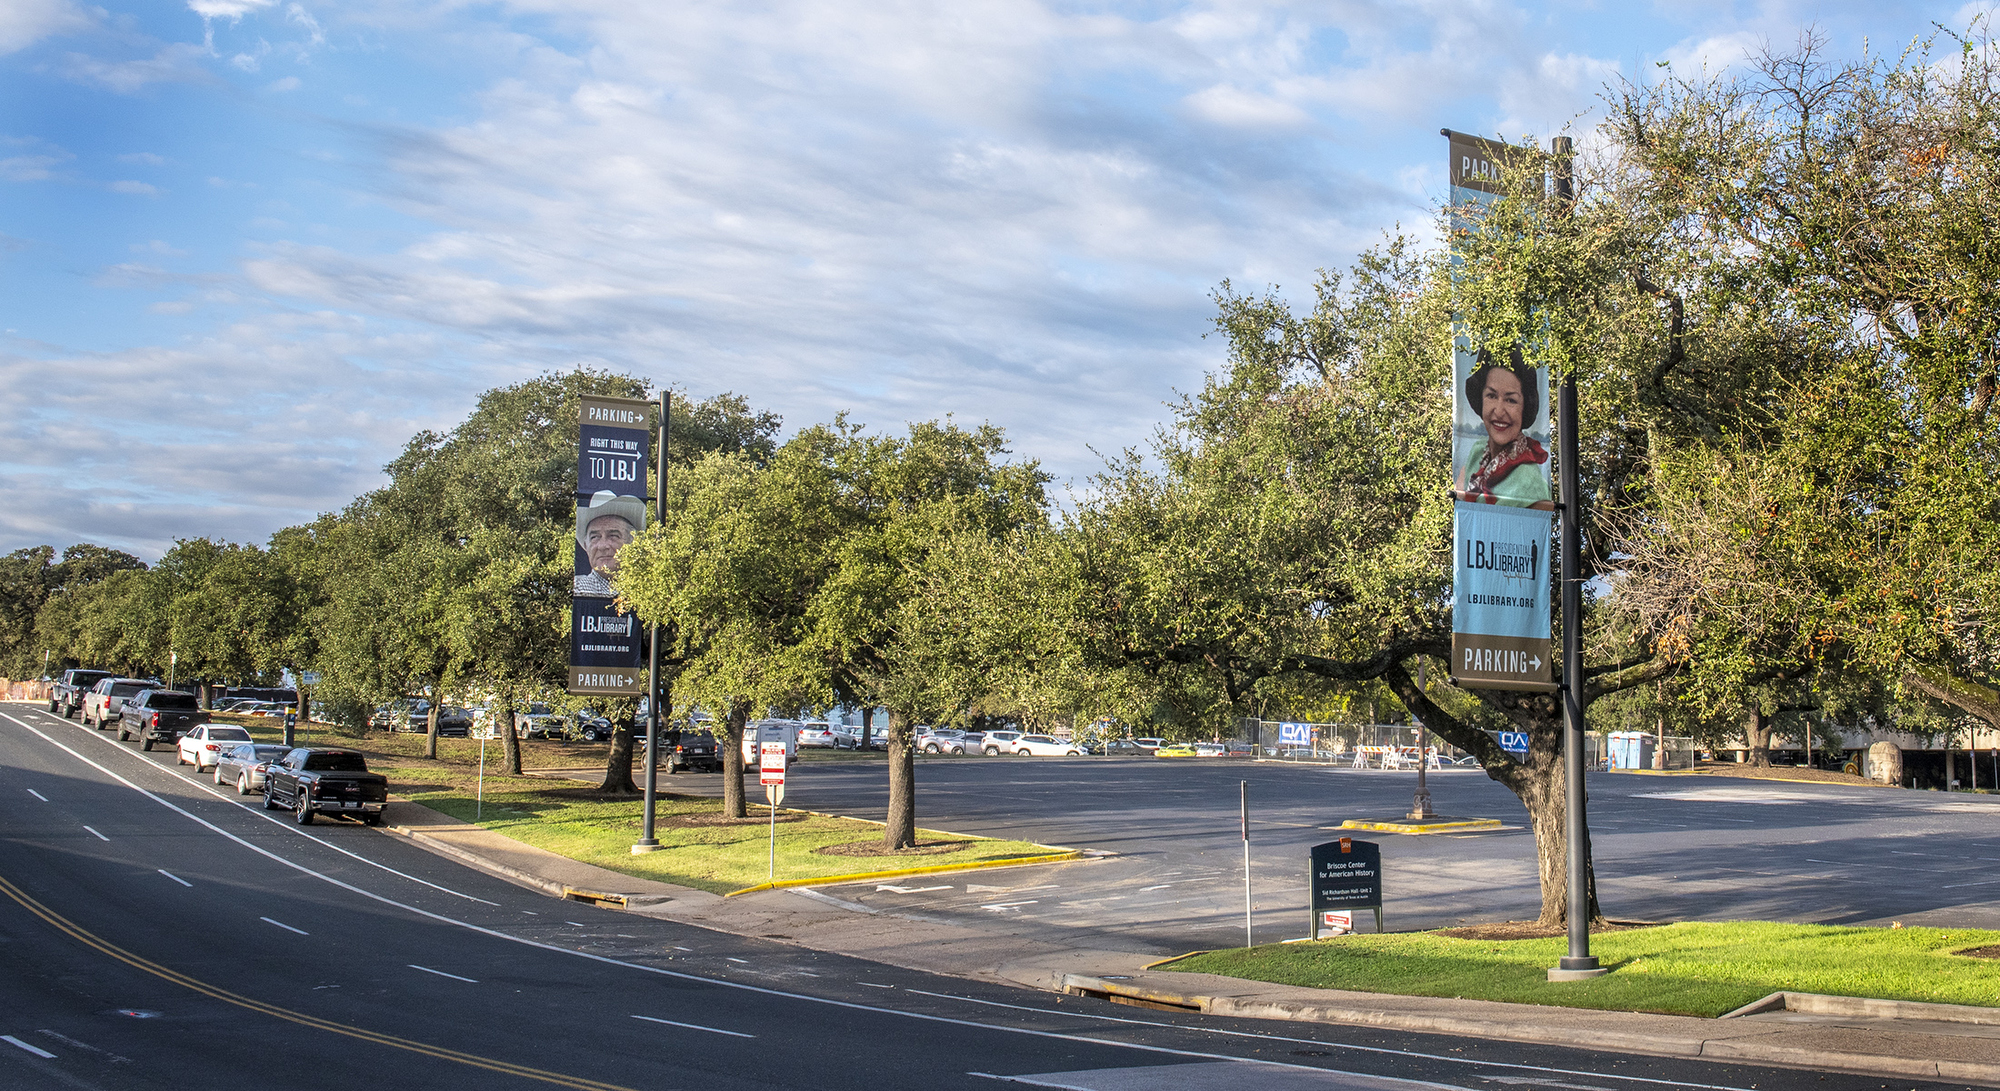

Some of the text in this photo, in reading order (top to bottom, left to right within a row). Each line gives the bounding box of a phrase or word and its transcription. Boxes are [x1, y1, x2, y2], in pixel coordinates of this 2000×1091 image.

[589, 407, 634, 423] PARKING
[590, 437, 639, 451] RIGHT THIS WAY
[589, 457, 636, 482] TO LBJ
[1466, 539, 1494, 570] LBJ
[1494, 542, 1531, 556] PRESIDENTIAL
[1494, 554, 1530, 574] LIBRARY
[1467, 593, 1534, 608] LBJLIBRARY.ORG
[580, 615, 601, 633] LBJ
[600, 623, 627, 633] LIBRARY
[581, 644, 630, 652] LBJLIBRARY.ORG
[1464, 647, 1527, 673] PARKING
[578, 673, 623, 687] PARKING
[1326, 861, 1366, 870] Briscoe Center
[1319, 869, 1374, 879] for American History
